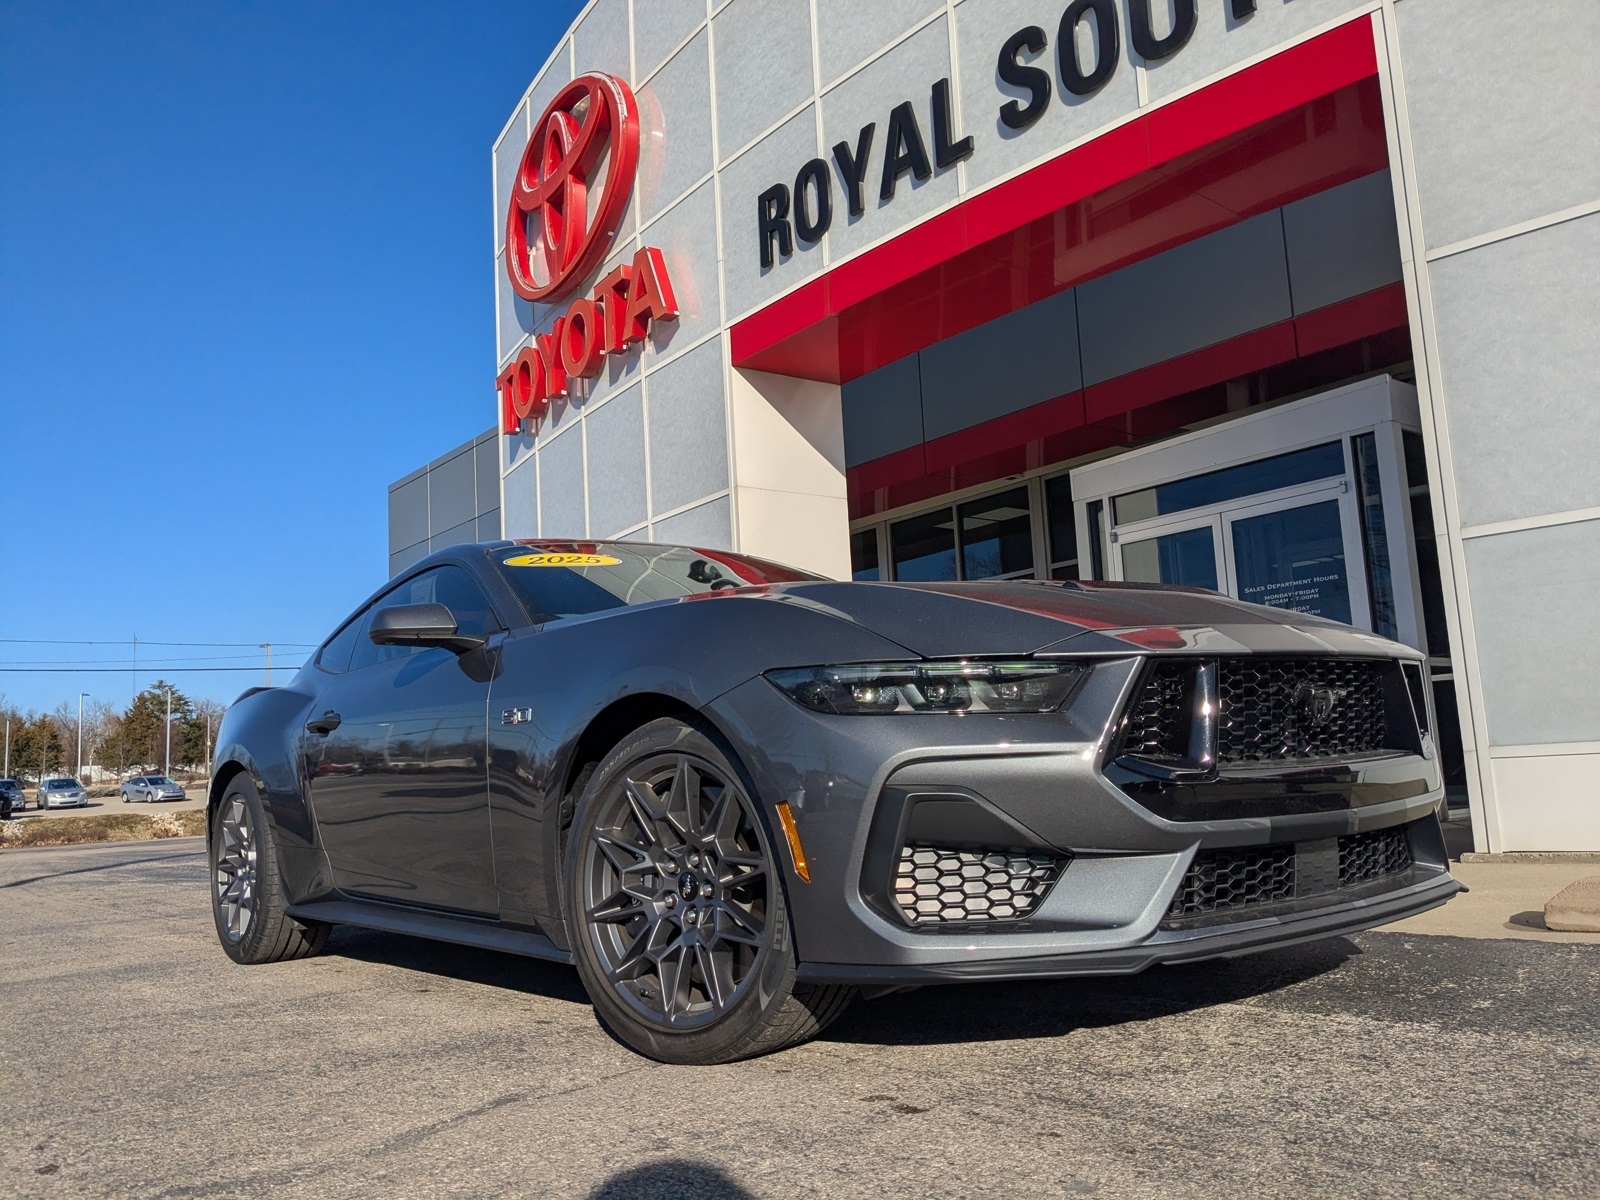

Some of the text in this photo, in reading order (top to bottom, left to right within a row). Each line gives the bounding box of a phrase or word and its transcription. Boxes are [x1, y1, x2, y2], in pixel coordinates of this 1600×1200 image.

[758, 0, 1257, 268] ROYAL SOU
[496, 246, 680, 435] TOYOTA
[527, 555, 602, 565] 2025
[1264, 588, 1319, 601] MONDAY-FRIDAY
